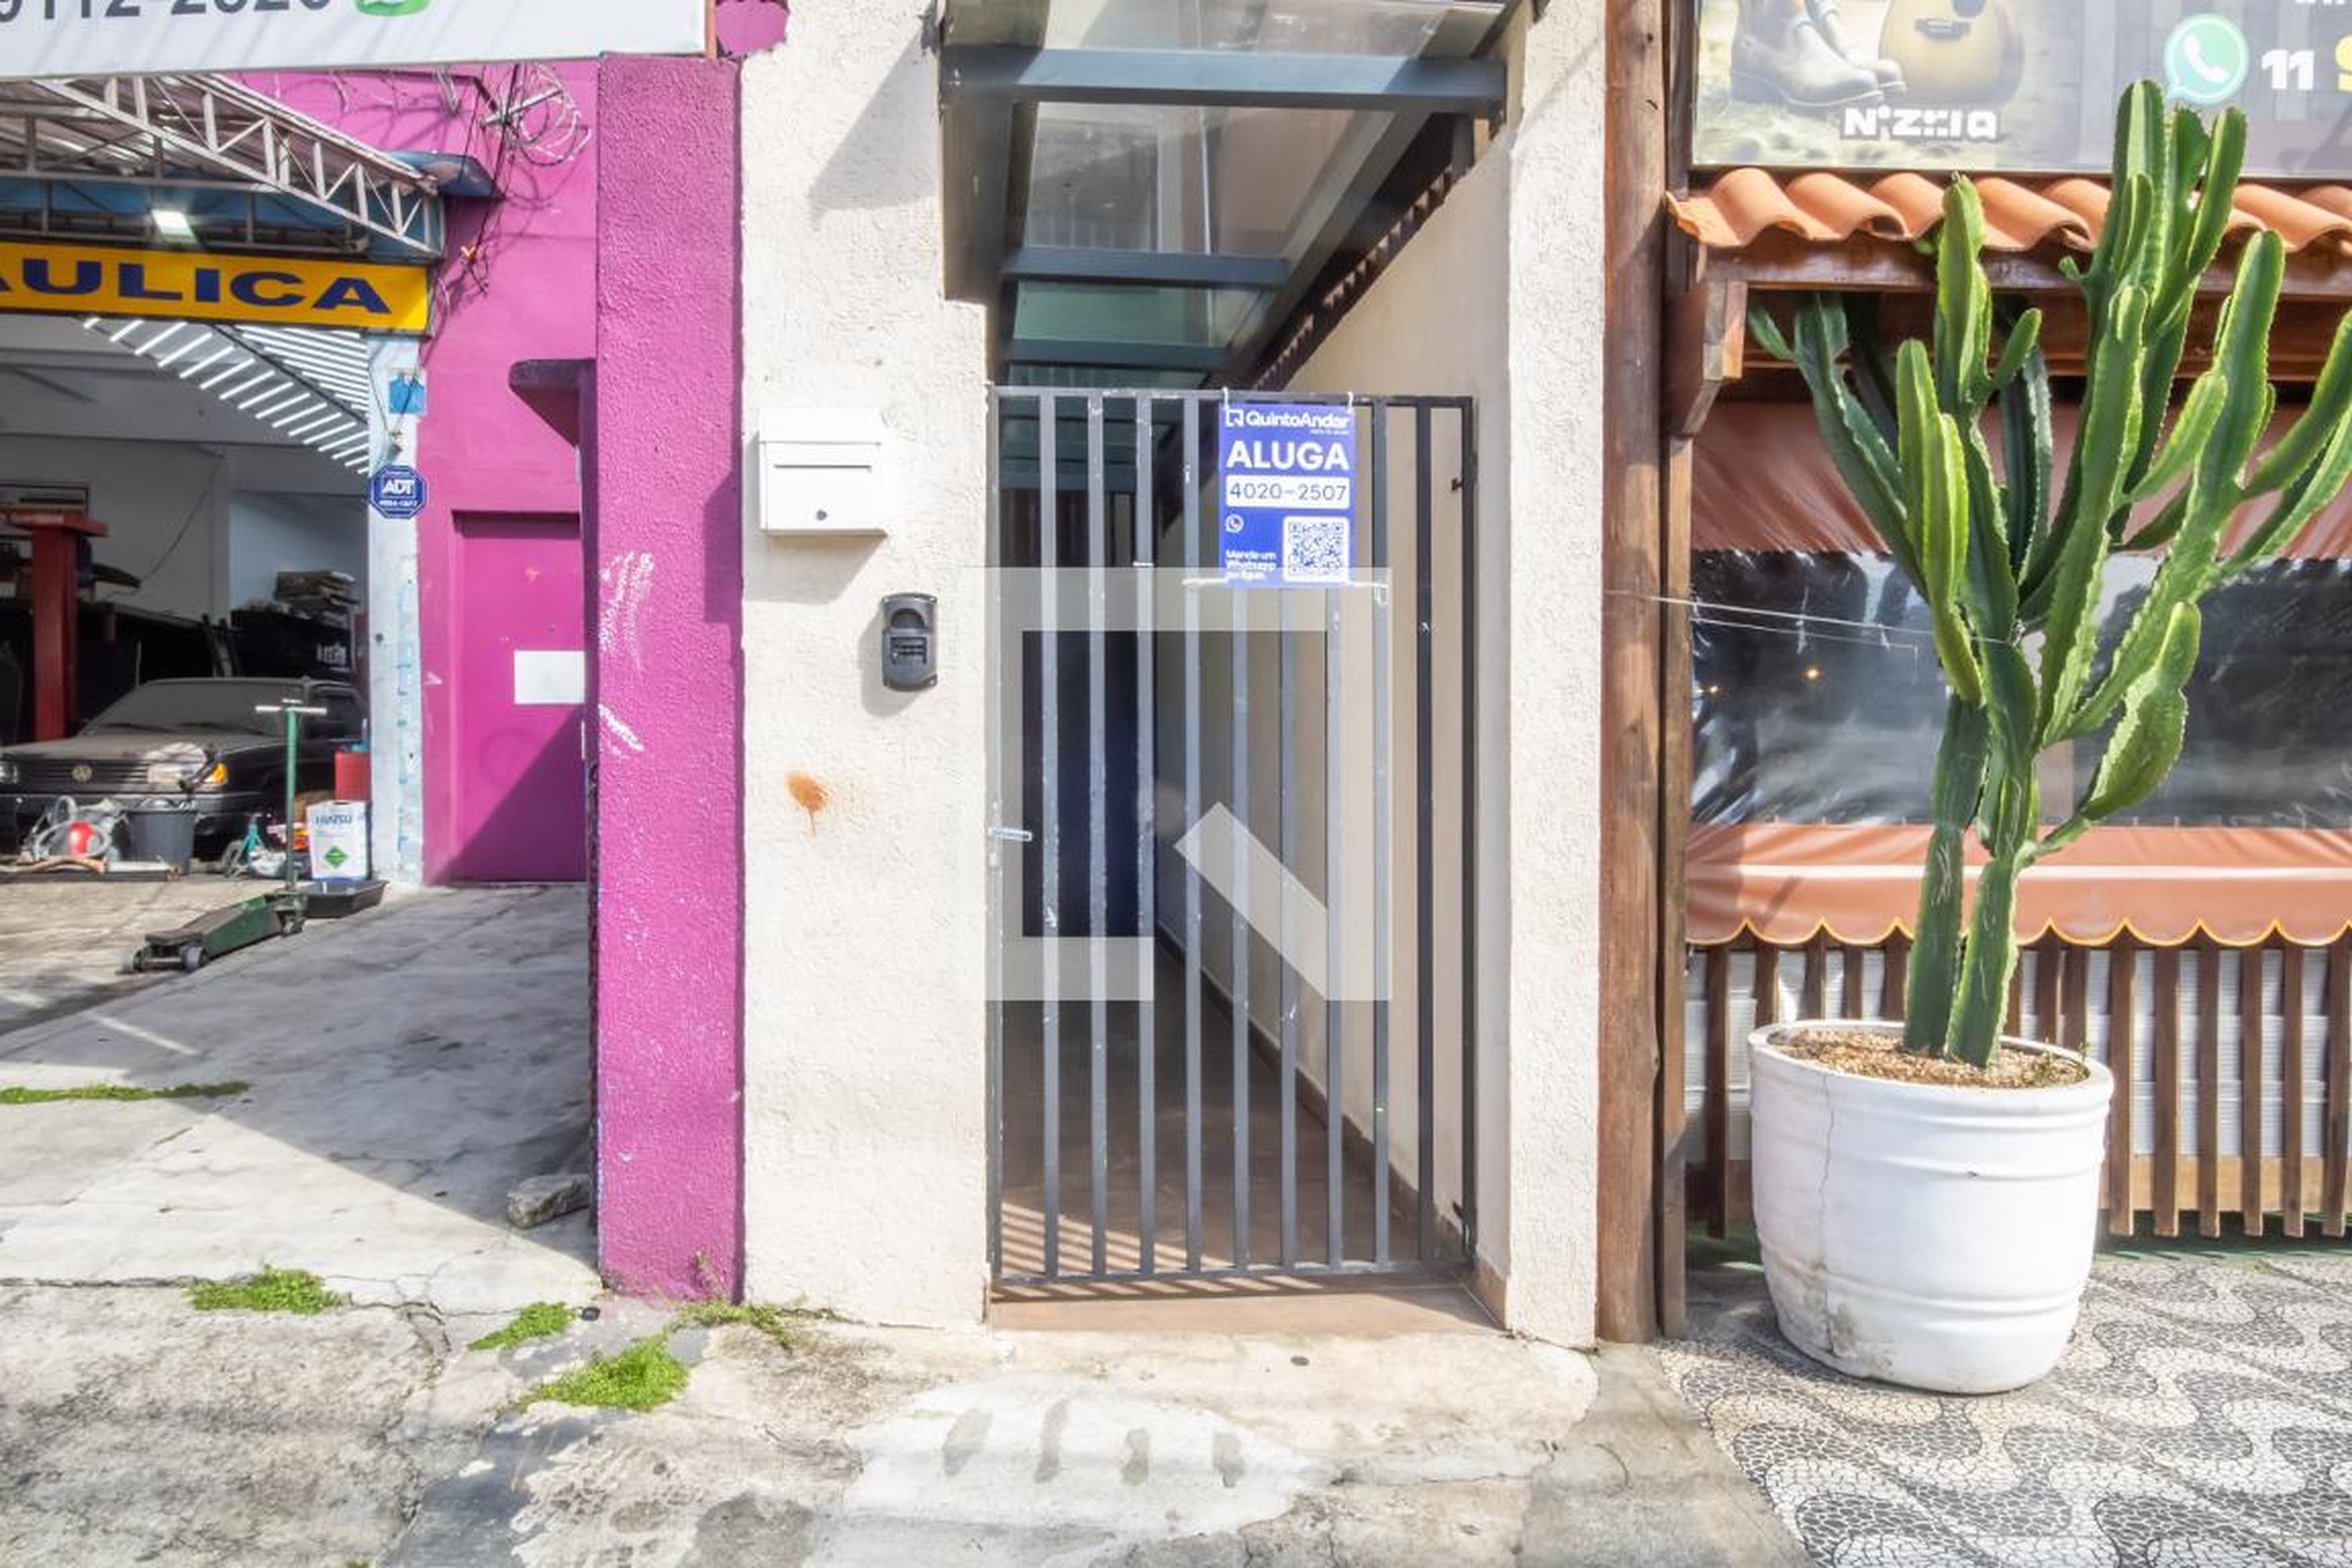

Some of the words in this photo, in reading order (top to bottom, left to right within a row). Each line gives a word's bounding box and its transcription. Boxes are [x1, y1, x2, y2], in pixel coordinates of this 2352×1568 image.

[2261, 49, 2314, 91] 11
[0, 258, 393, 314] ULICA
[1246, 411, 1350, 428] QuintoAndar
[1226, 440, 1350, 470] ALUGA
[381, 479, 415, 495] ADT
[1230, 482, 1347, 501] 4020-2507
